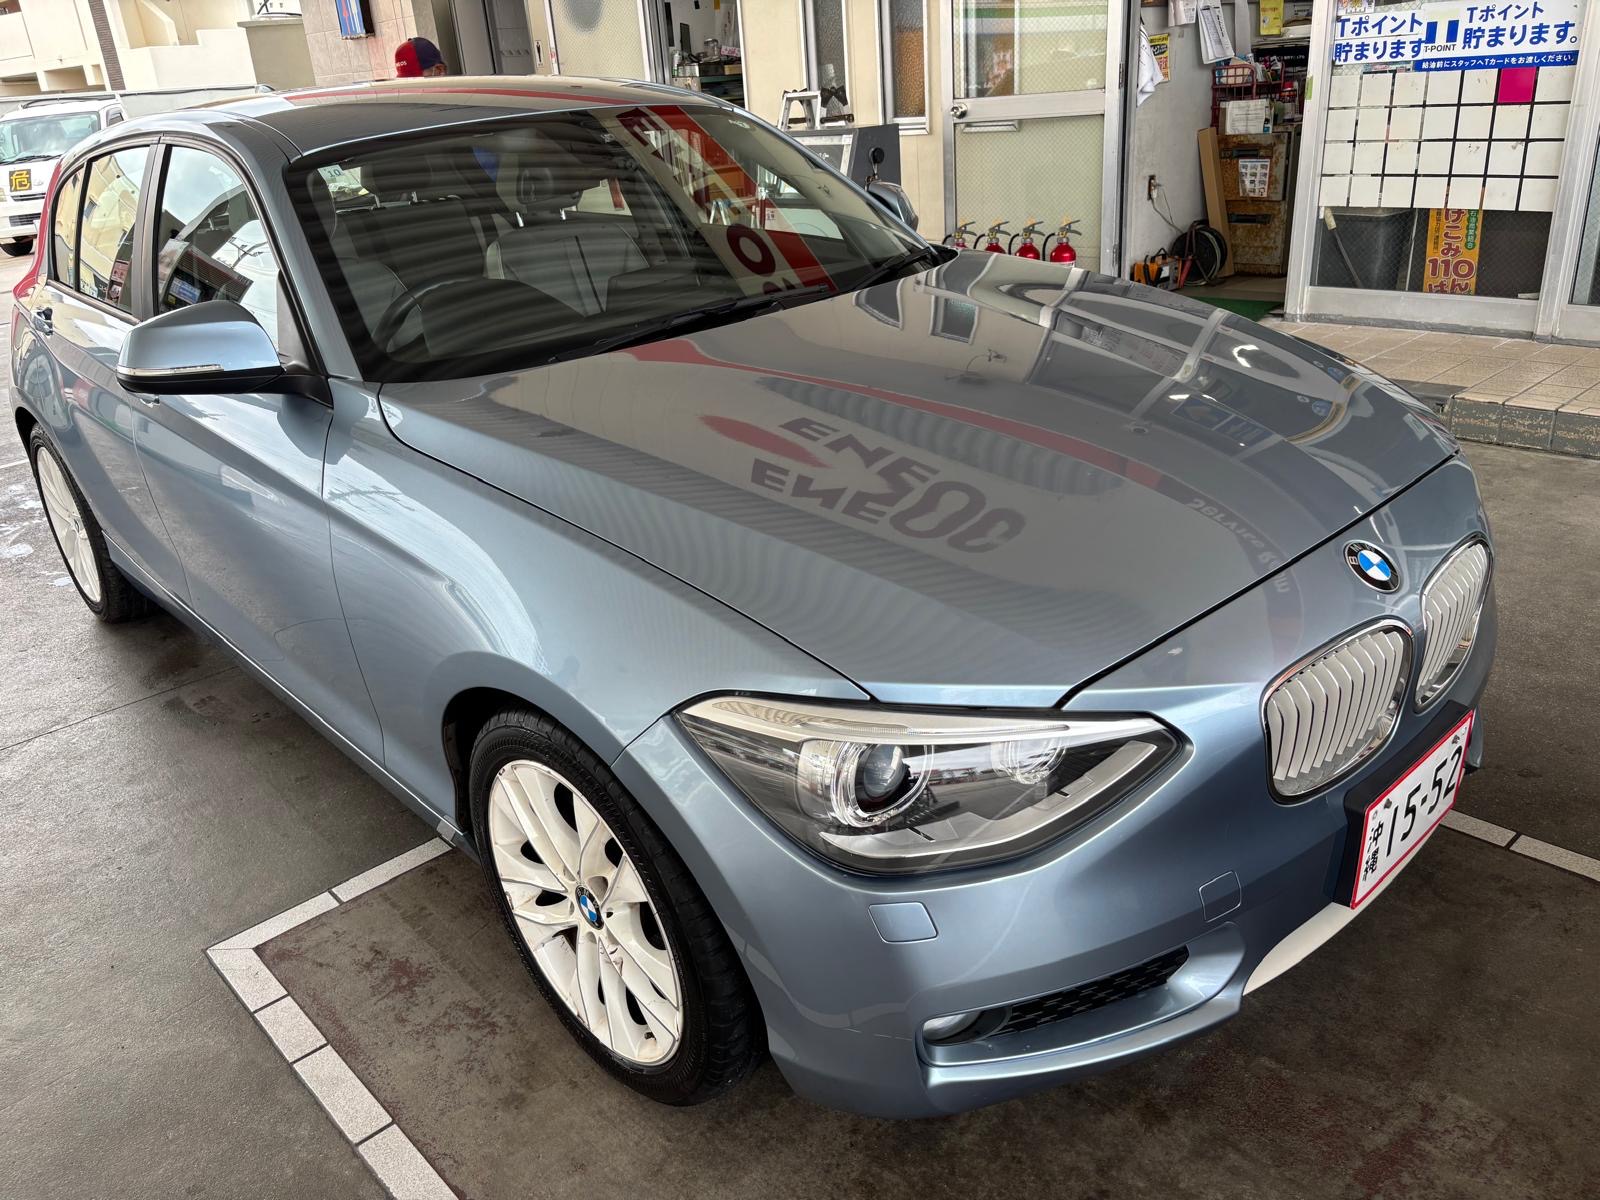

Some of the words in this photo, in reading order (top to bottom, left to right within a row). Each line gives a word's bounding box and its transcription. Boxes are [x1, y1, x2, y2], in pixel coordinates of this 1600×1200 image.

[1467, 1, 1544, 23] Tポイント
[1336, 12, 1423, 37] Tポイント
[1462, 20, 1578, 50] 貯まります。
[1334, 38, 1425, 62] 貯まります
[1423, 43, 1457, 53] T-POINT
[10, 170, 30, 191] 危
[1427, 257, 1475, 279] 110
[1386, 745, 1463, 858] 15-52
[1362, 820, 1385, 882] 沖縄
